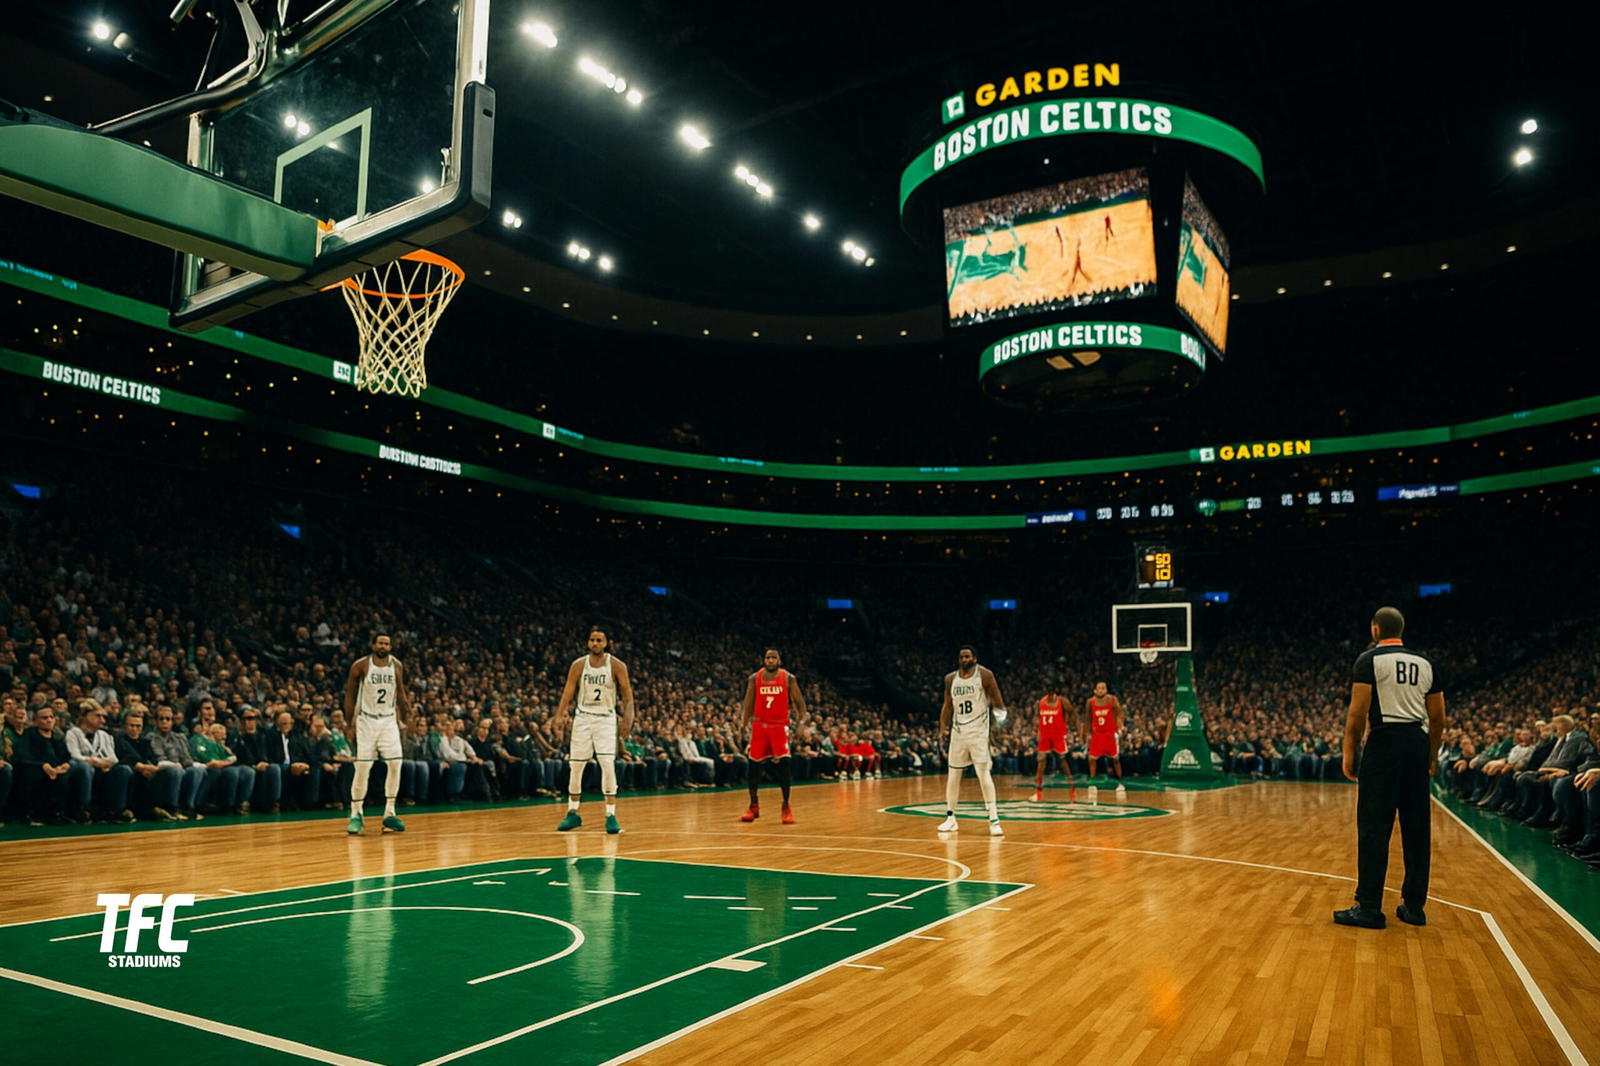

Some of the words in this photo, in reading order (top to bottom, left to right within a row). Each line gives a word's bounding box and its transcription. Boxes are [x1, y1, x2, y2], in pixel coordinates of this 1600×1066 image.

[975, 63, 1120, 107] GARDEN
[933, 108, 1030, 171] BOSTON
[1040, 101, 1173, 135] CELTICS
[993, 329, 1053, 365] BOSTON
[1057, 324, 1143, 346] CELTICS
[102, 376, 161, 405] CELTICS
[1219, 440, 1311, 461] GARDEN
[376, 688, 387, 704] 2
[593, 688, 602, 702] 2
[765, 695, 775, 709] 7
